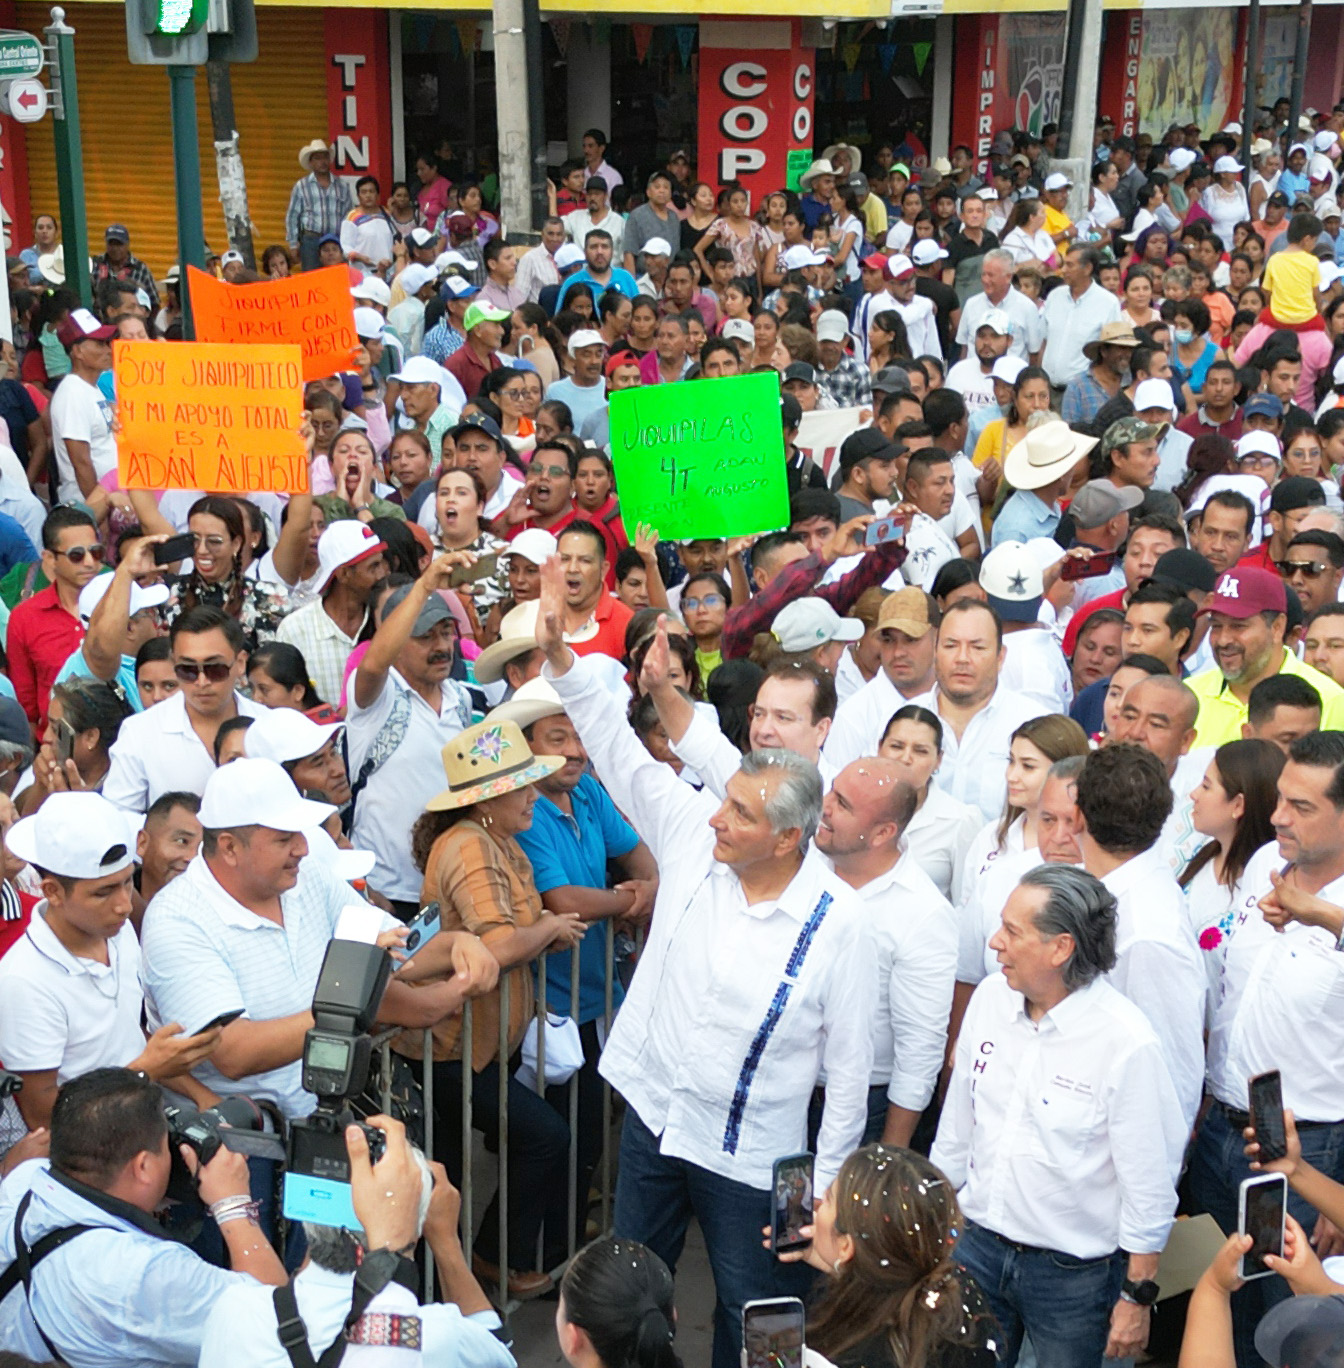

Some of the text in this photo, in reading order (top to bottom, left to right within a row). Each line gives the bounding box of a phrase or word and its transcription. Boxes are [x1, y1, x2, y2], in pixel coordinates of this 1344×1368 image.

[302, 308, 338, 333] CON
[146, 400, 166, 424] MI
[242, 404, 294, 431] TOTAL
[175, 430, 230, 450] ES A
[214, 453, 309, 493] AUGUSTO
[660, 456, 697, 497] 4T
